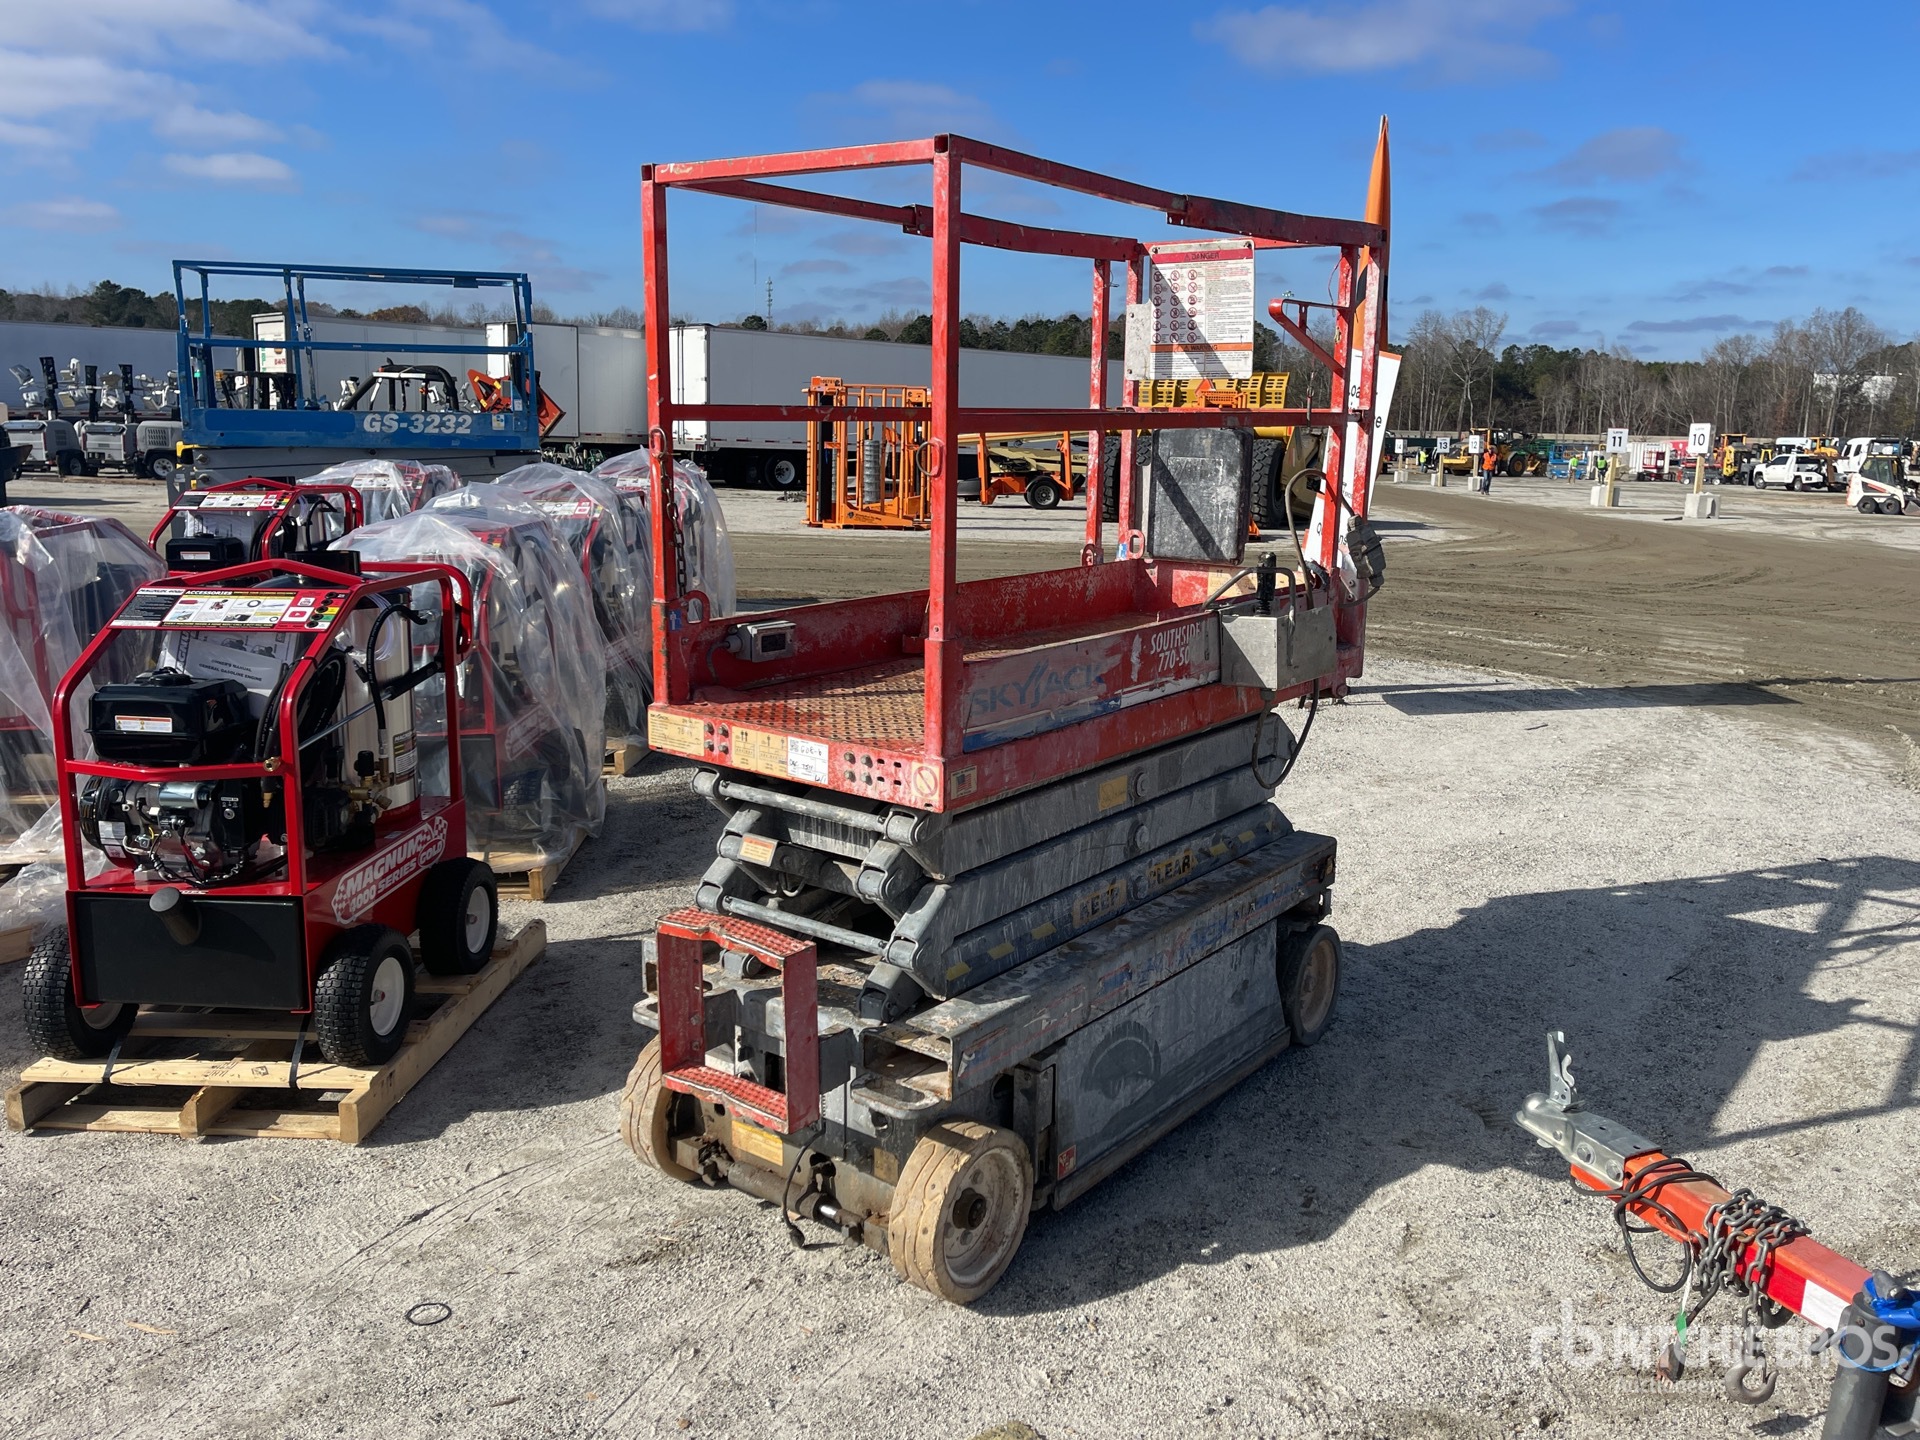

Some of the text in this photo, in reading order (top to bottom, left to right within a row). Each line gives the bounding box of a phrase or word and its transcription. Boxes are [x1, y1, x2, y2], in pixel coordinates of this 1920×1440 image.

[1191, 251, 1219, 260] DANGER
[363, 413, 473, 434] GS-3232
[1439, 441, 1448, 450] 13
[1470, 440, 1478, 449] 12
[1611, 436, 1622, 447] 11
[1692, 433, 1706, 446] 10
[1150, 623, 1201, 655] SOUTHSIDE
[198, 663, 262, 682] GENERAL GASOLINE ENGINE
[211, 659, 252, 673] OWNER'S MANUAL
[971, 657, 1106, 717] SKYJACK
[345, 834, 421, 896] MAGNUM
[348, 840, 443, 913] 4000 SERIES GOLD
